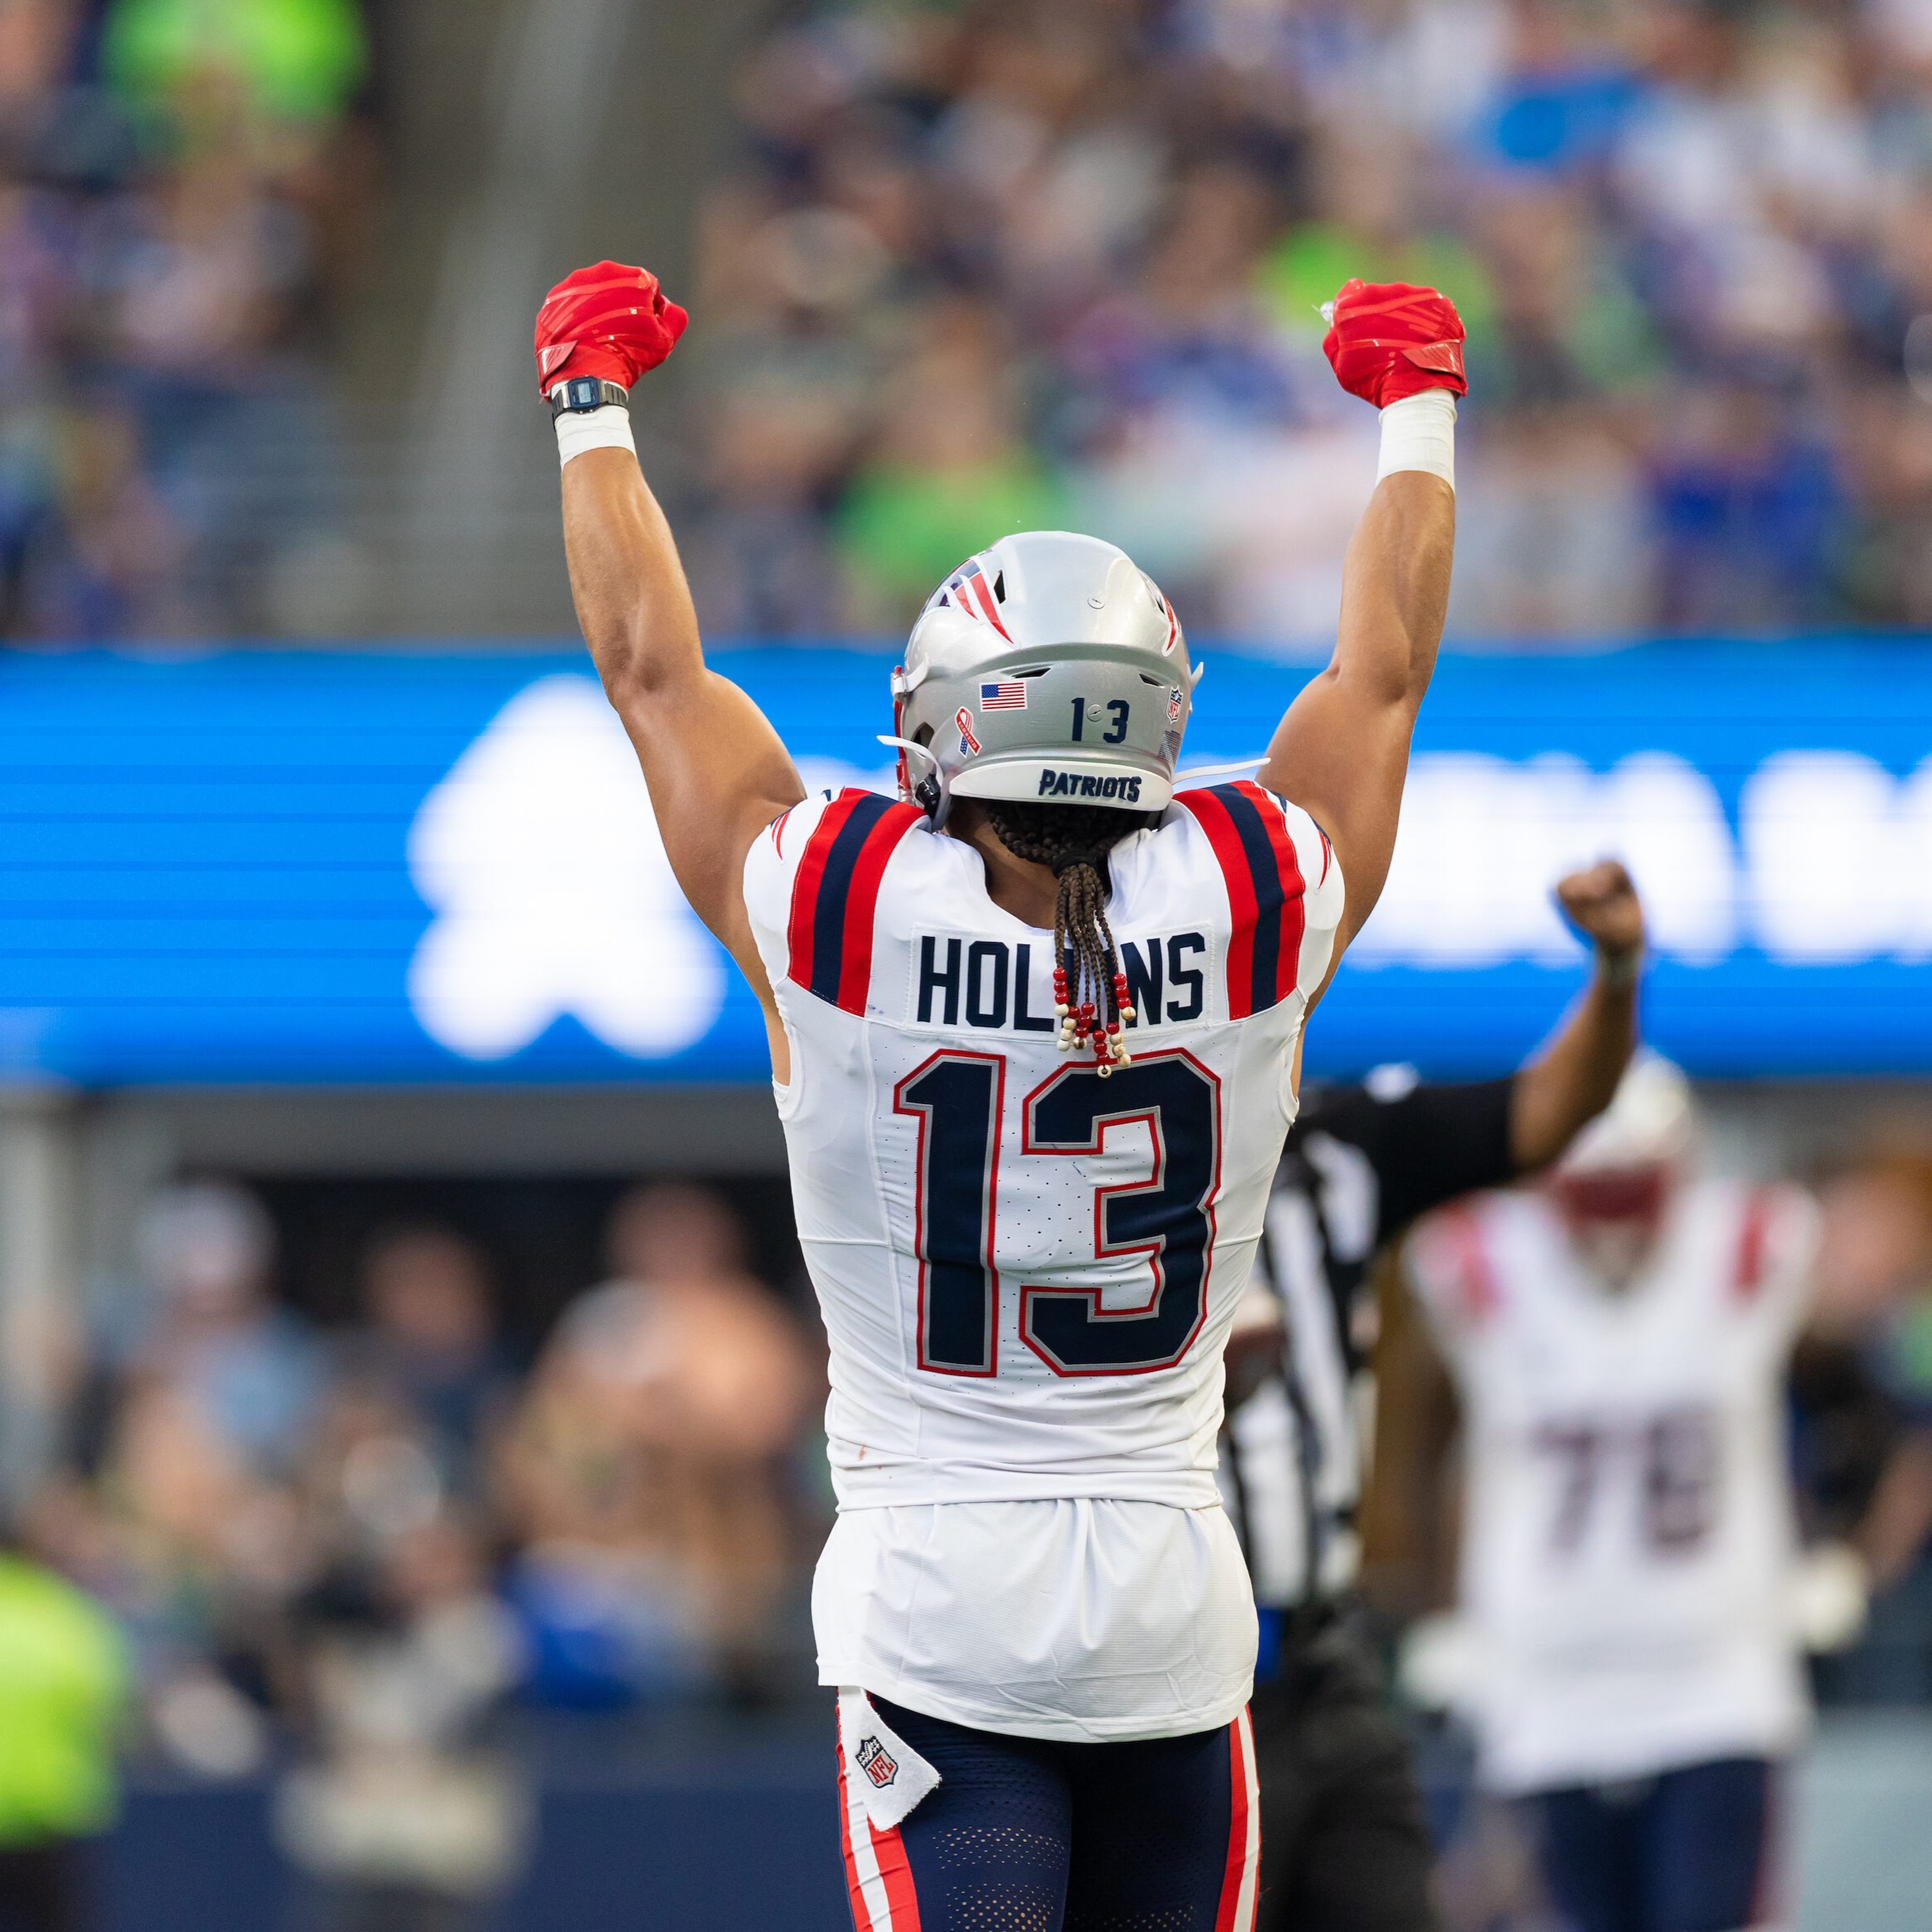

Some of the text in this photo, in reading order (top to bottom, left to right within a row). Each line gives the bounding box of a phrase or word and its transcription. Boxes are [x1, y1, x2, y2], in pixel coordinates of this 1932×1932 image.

[1071, 697, 1130, 743] 13
[1038, 769, 1142, 803] PATRIOTS
[893, 1047, 1221, 1377] 13
[867, 1754, 895, 1784] NFL
